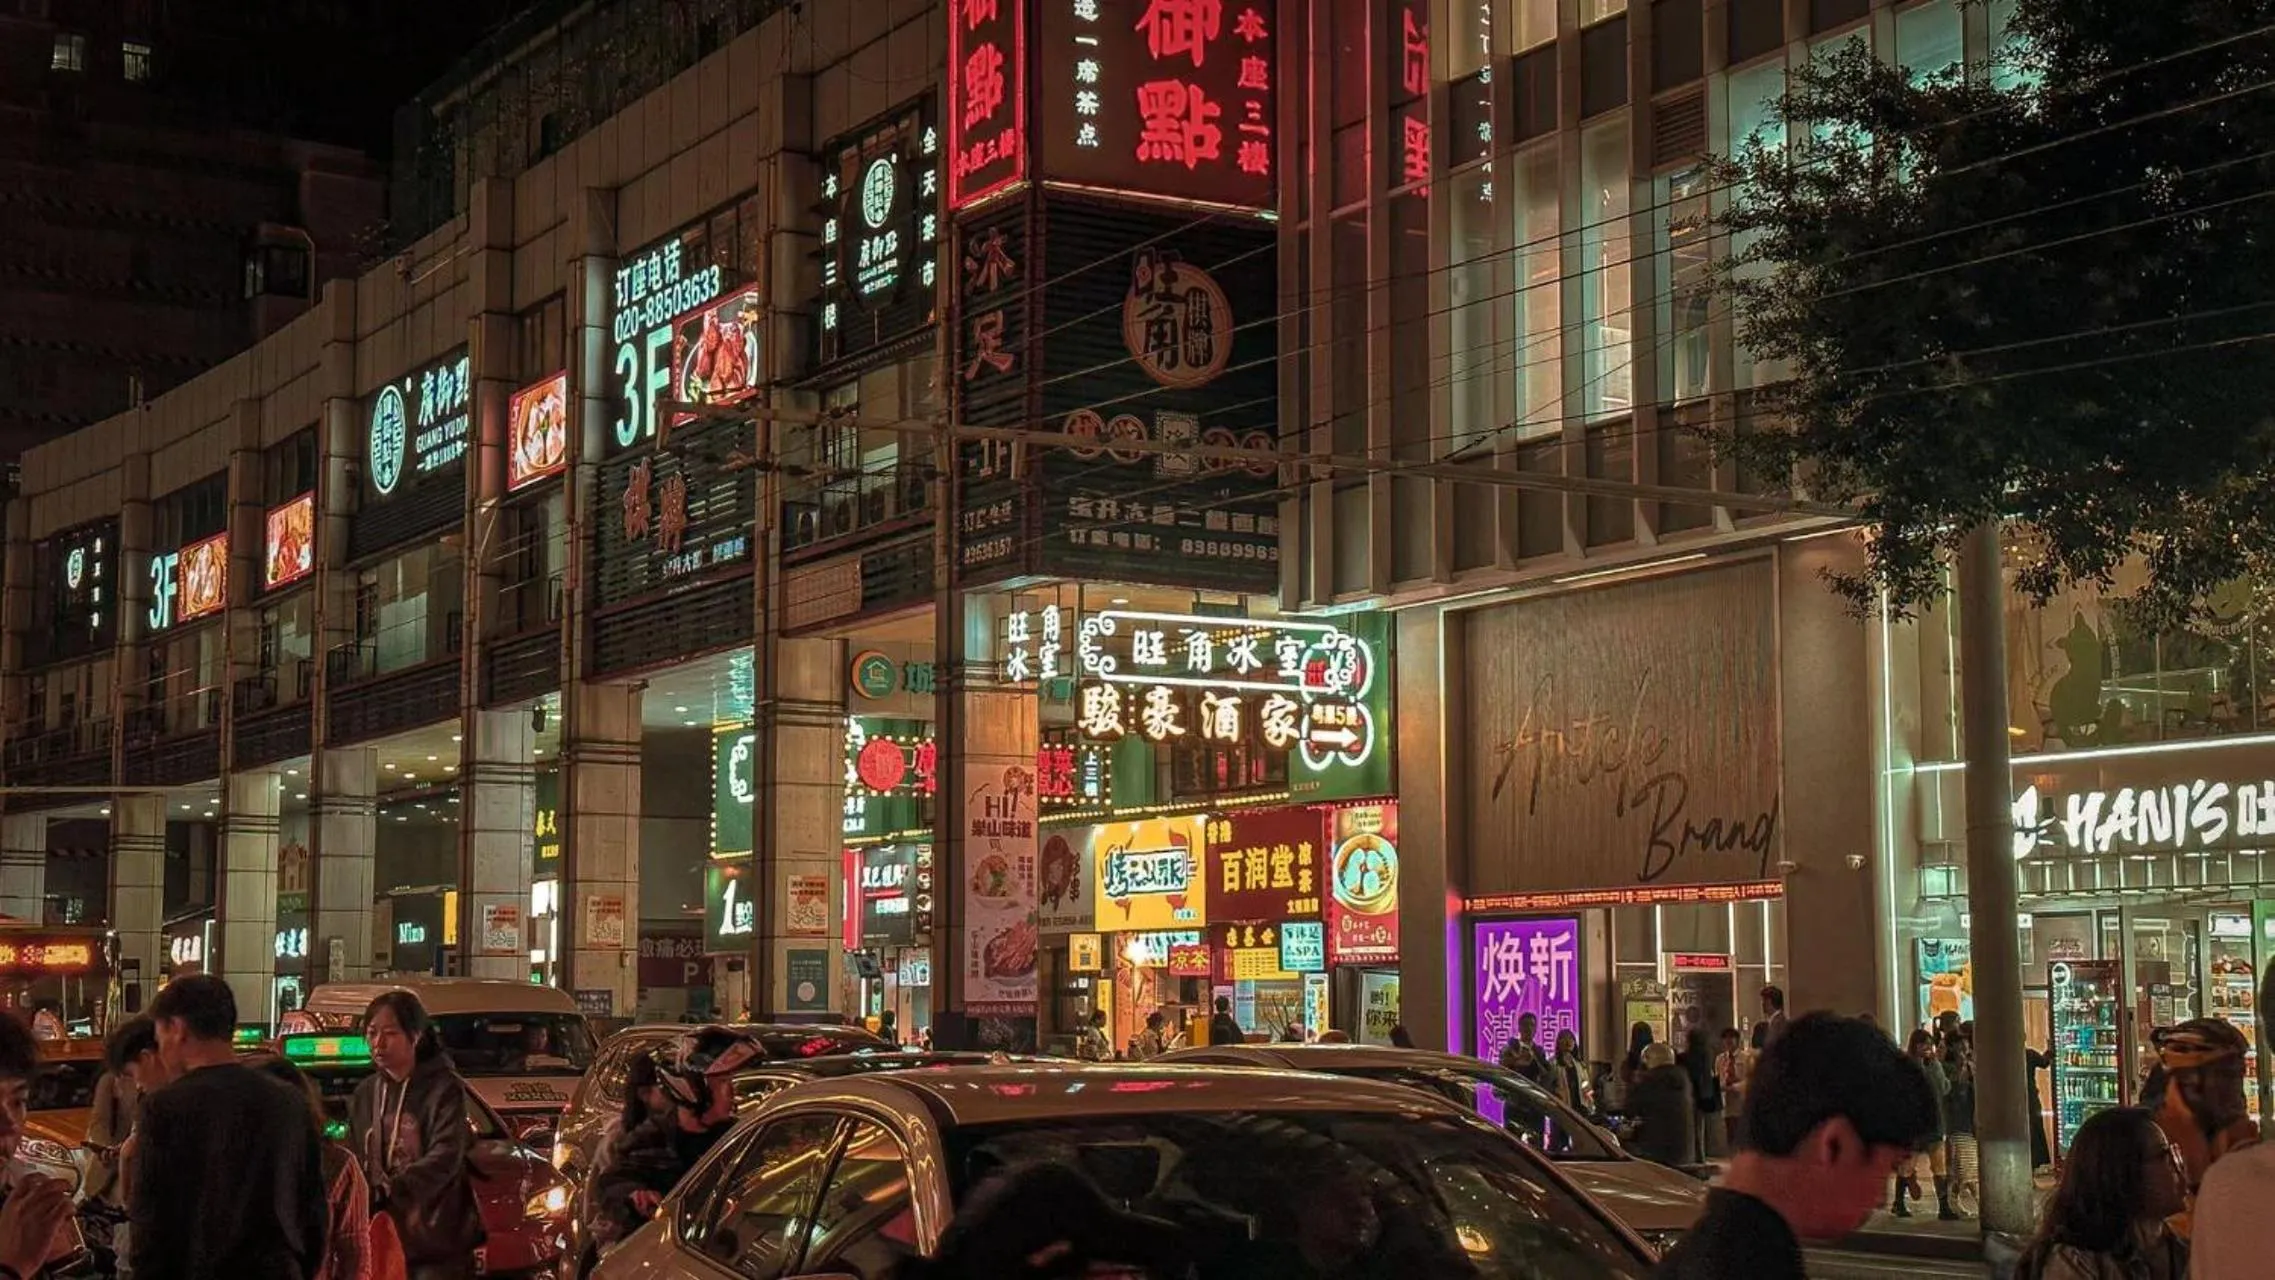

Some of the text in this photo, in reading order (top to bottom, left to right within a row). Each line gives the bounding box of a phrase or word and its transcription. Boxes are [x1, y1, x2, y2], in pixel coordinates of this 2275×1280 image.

[615, 324, 673, 447] 3F
[149, 552, 179, 629] 3F
[1008, 605, 1060, 643] 旺角
[1132, 627, 1305, 677] 旺角冰室
[1078, 683, 1301, 748] 駿豪酒家
[1631, 772, 1779, 882] Brand
[2060, 779, 2230, 853] HANI'S
[1482, 931, 1573, 1003] 焕新
